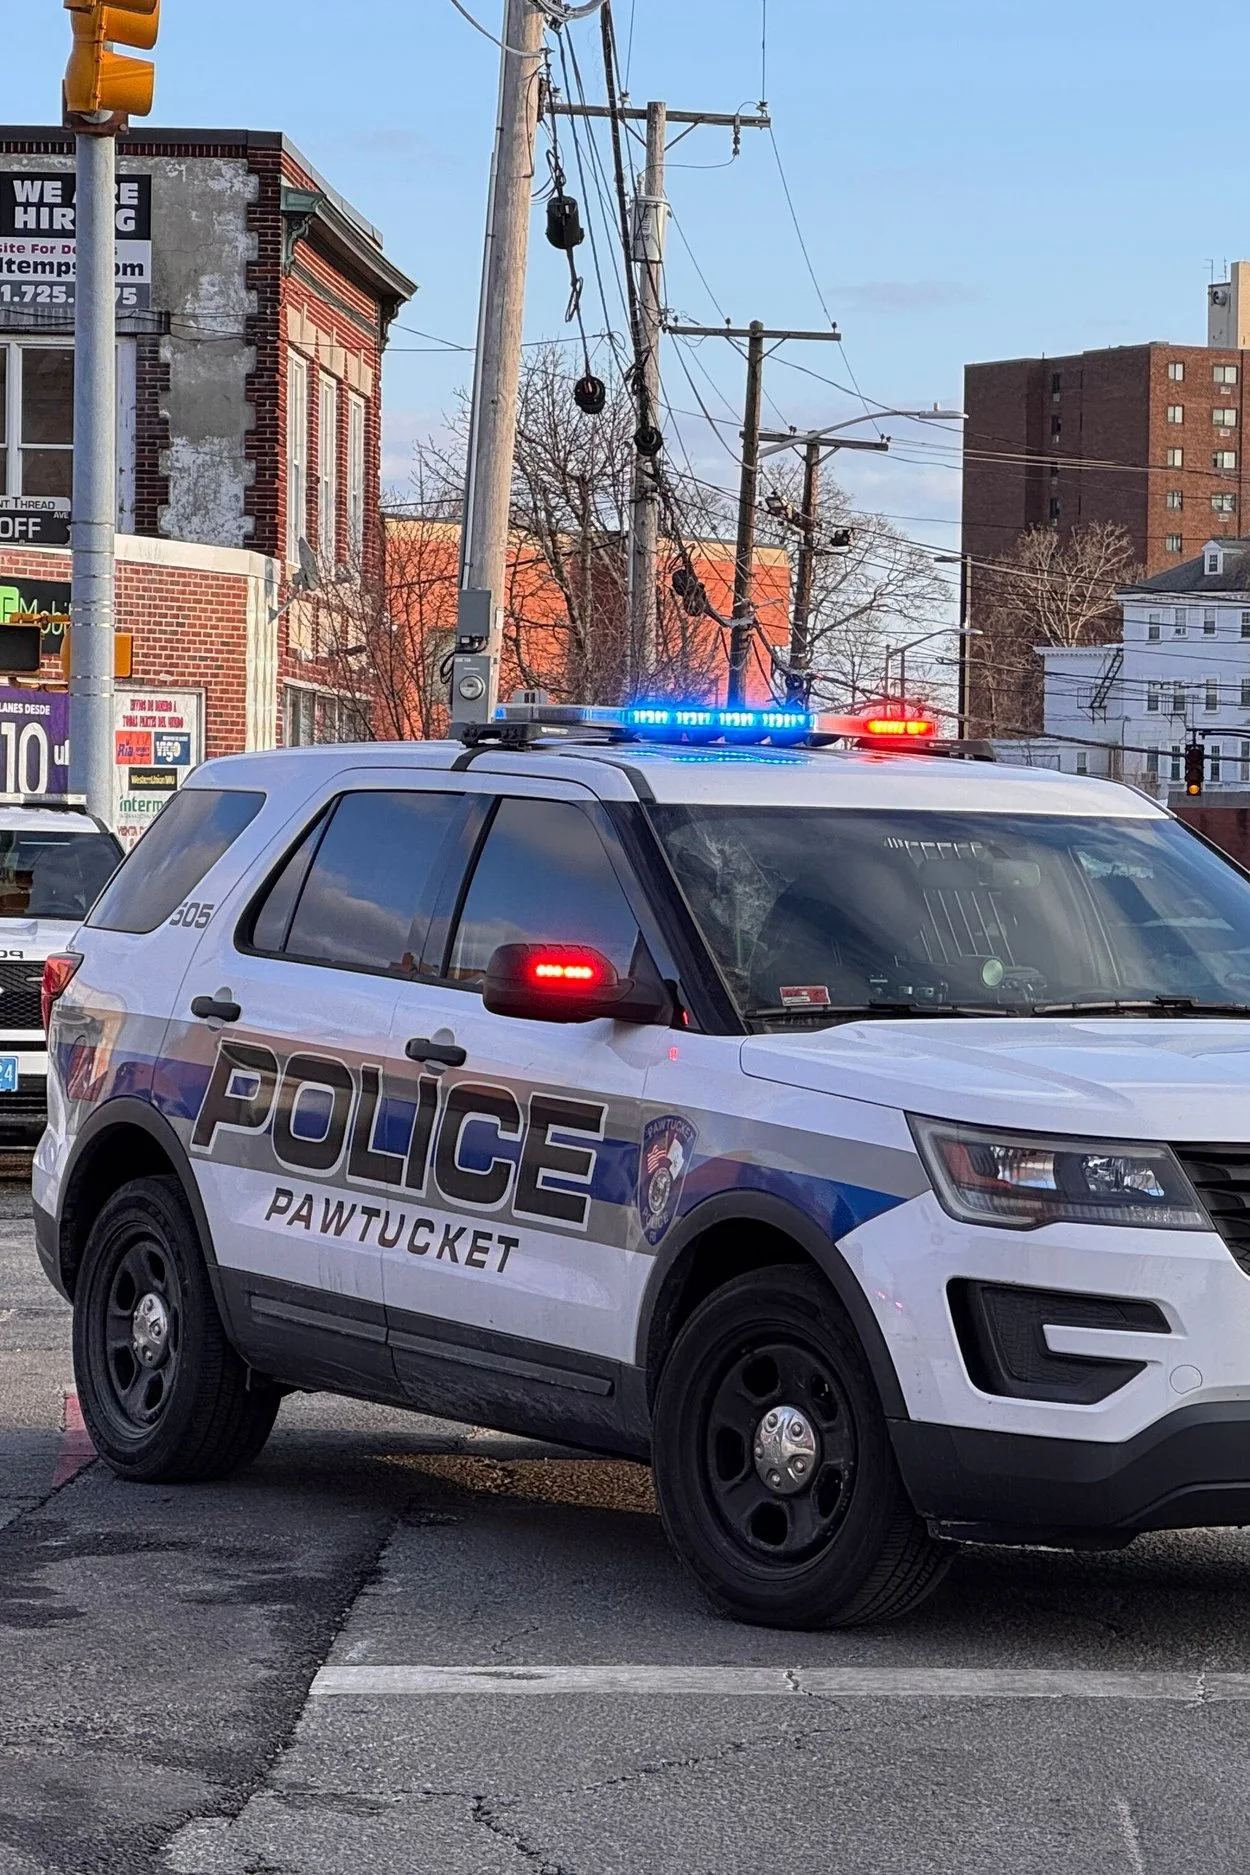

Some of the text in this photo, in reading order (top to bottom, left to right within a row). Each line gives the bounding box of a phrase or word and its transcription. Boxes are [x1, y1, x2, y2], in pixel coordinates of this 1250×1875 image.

[13, 180, 62, 203] WE
[14, 206, 136, 232] HIRG
[31, 244, 56, 254] For
[12, 497, 56, 510] THREAD
[53, 511, 69, 519] AVE
[24, 703, 51, 716] DESDE
[189, 1038, 609, 1232] POLICE
[264, 1187, 520, 1274] PAWTUCKET
